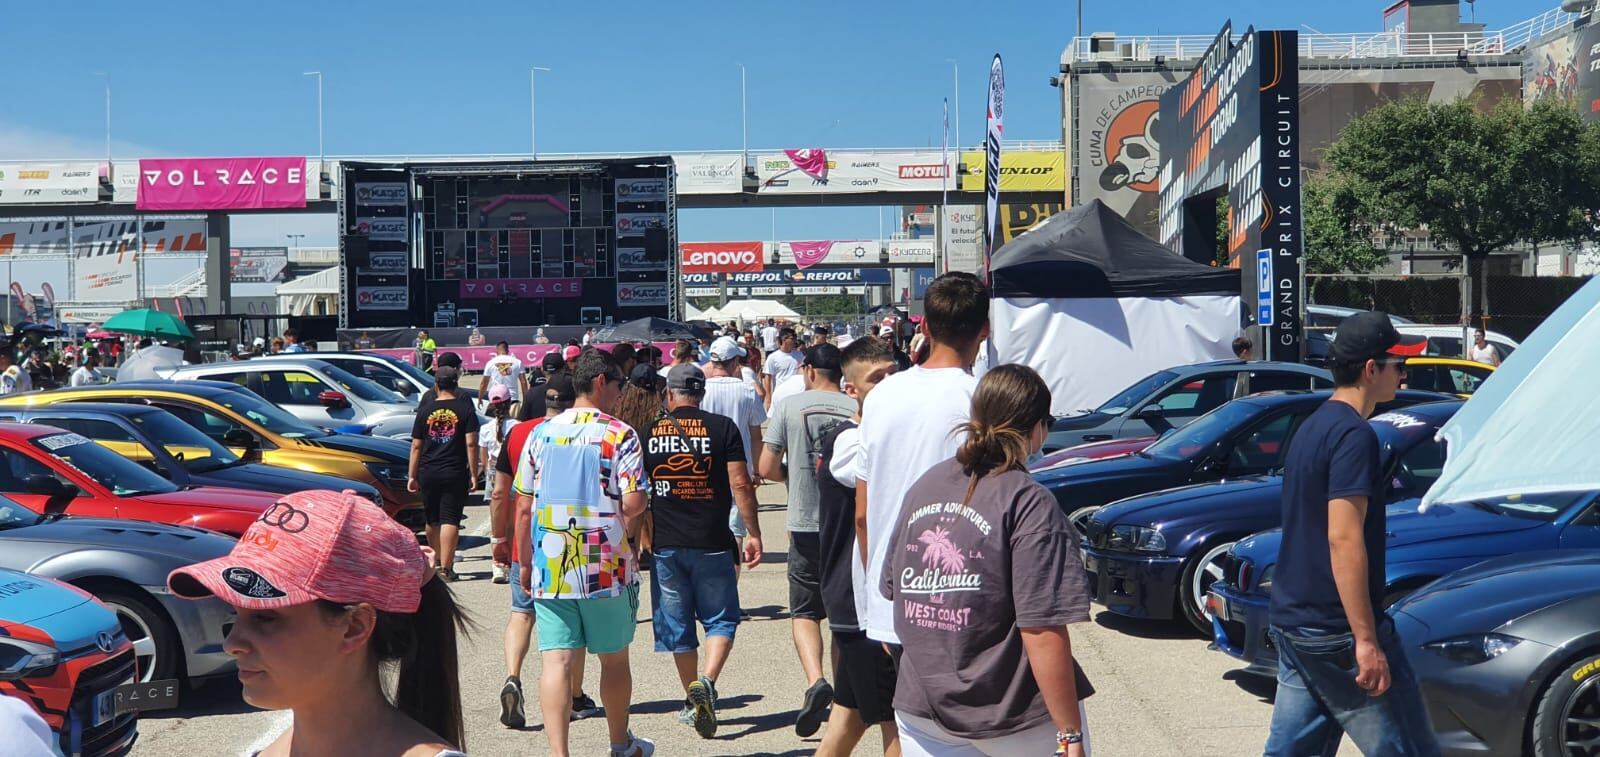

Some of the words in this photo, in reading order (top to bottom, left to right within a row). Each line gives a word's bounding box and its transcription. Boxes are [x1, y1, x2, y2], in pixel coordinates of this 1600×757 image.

[1202, 28, 1231, 90] CIRCUIT
[1217, 33, 1253, 106] RICARDO
[1096, 109, 1112, 128] DE
[1210, 92, 1238, 149] TORMO
[1090, 129, 1103, 167] CUNA
[1278, 94, 1291, 188] CIRCUIT
[999, 167, 1053, 176] UNLOP
[1279, 205, 1292, 257] PRIX
[682, 251, 756, 265] Lenovo
[735, 273, 782, 282] REPSOL
[806, 271, 853, 281] REPSOL
[1280, 277, 1293, 346] GRAND
[900, 566, 982, 595] California
[904, 599, 936, 619] WEST
[937, 607, 971, 626] COAST
[916, 618, 938, 628] SURF
